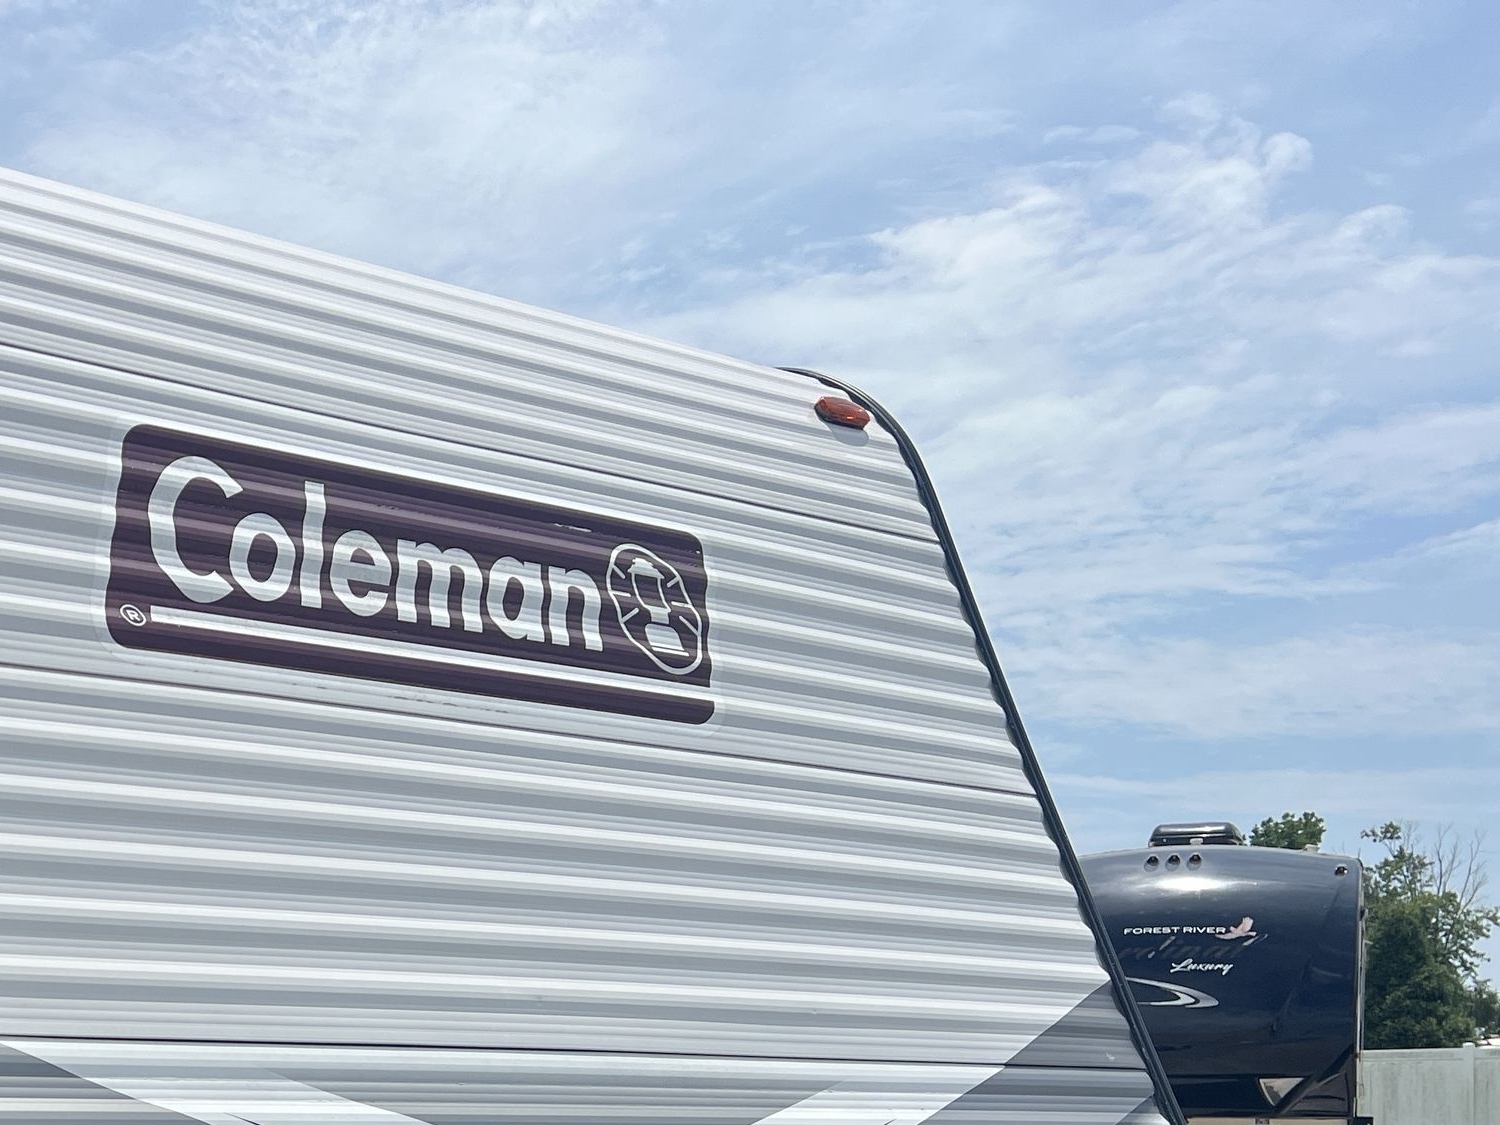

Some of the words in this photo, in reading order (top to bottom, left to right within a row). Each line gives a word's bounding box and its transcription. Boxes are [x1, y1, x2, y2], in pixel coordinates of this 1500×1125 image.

[147, 455, 604, 652] Coleman
[1123, 926, 1181, 935] FOREST
[1183, 926, 1227, 934] RIVER
[1169, 958, 1234, 976] Luxury
